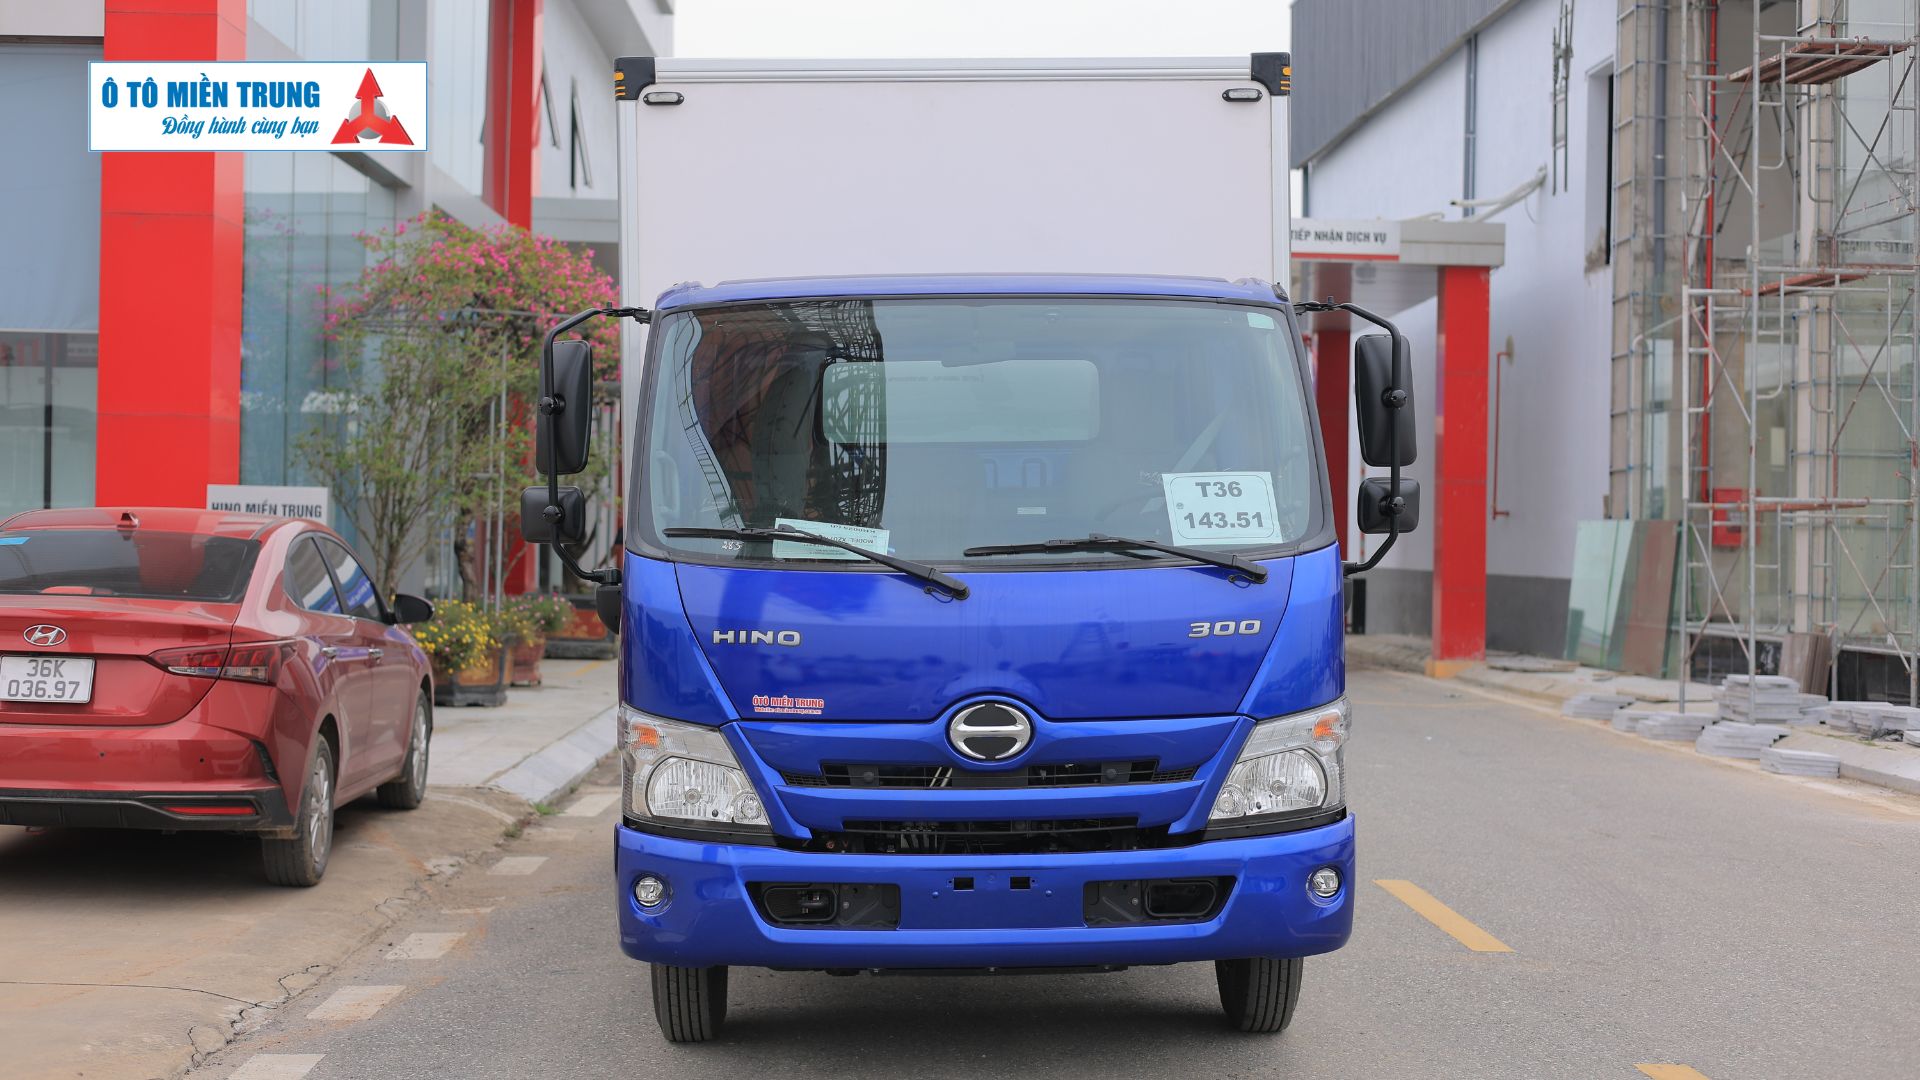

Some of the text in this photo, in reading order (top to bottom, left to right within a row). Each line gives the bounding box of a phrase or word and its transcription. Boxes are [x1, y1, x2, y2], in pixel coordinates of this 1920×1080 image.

[1195, 481, 1243, 498] T36
[282, 504, 322, 518] TRUNG
[1184, 511, 1264, 529] 143.51
[1188, 620, 1261, 638] 300
[713, 630, 801, 646] HINO
[26, 659, 66, 678] 36K
[7, 679, 80, 699] 036.97
[795, 698, 825, 709] TRUNG
